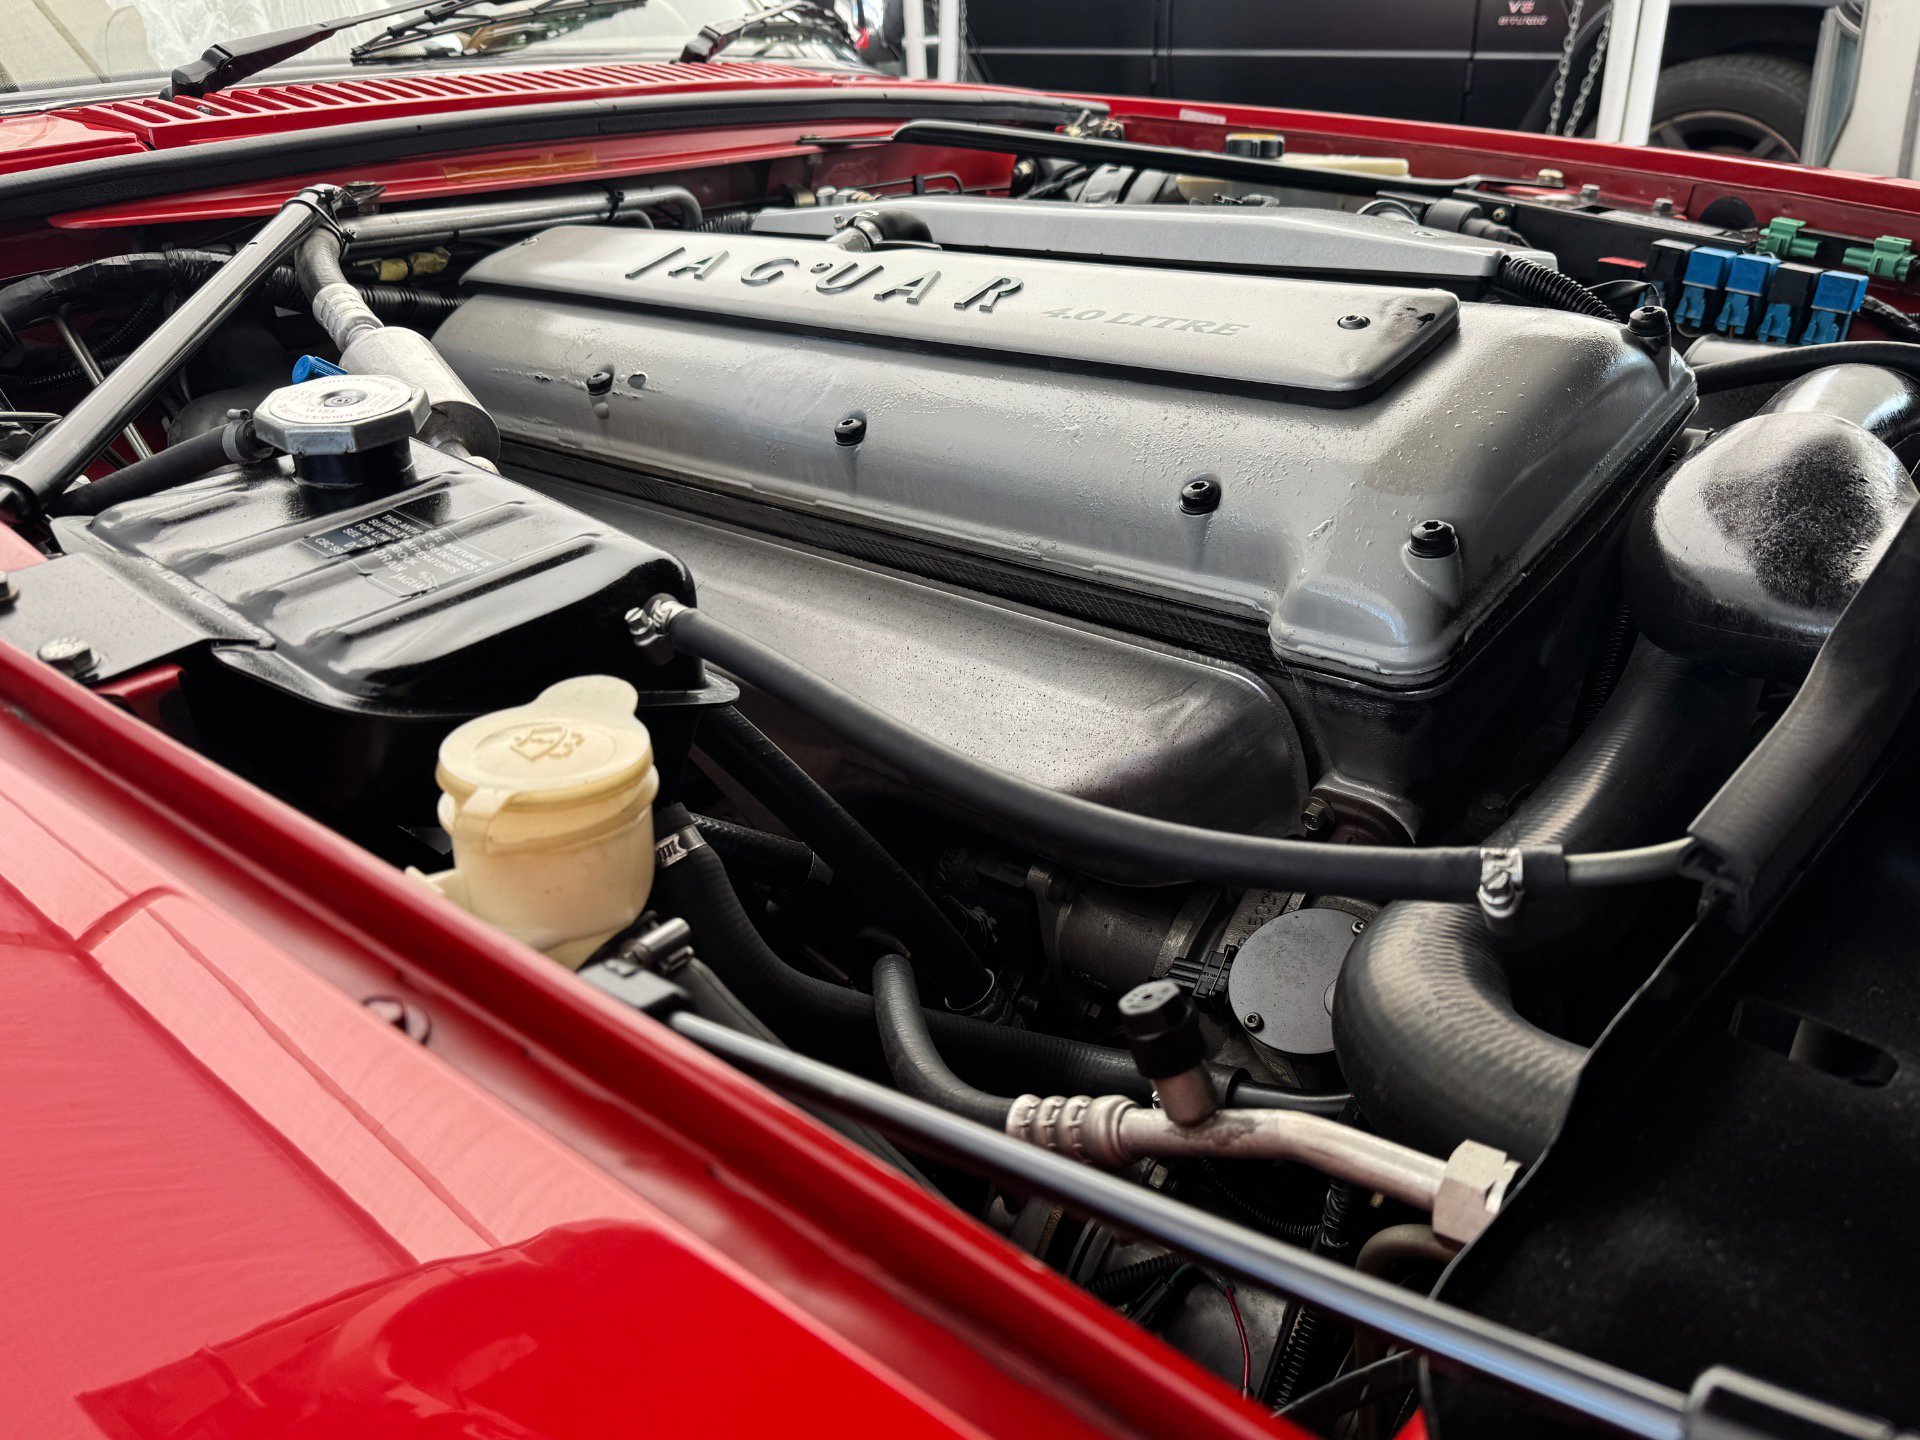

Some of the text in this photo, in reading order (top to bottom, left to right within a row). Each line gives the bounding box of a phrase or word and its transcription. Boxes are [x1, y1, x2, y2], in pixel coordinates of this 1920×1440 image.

[625, 246, 1024, 313] JAGUAR
[1042, 305, 1249, 338] 4.0 LITRE
[355, 523, 375, 533] FOR
[368, 519, 407, 539] SUITABLE
[381, 514, 402, 526] THIS
[343, 528, 362, 538] SEE
[373, 550, 408, 572] DRAIN
